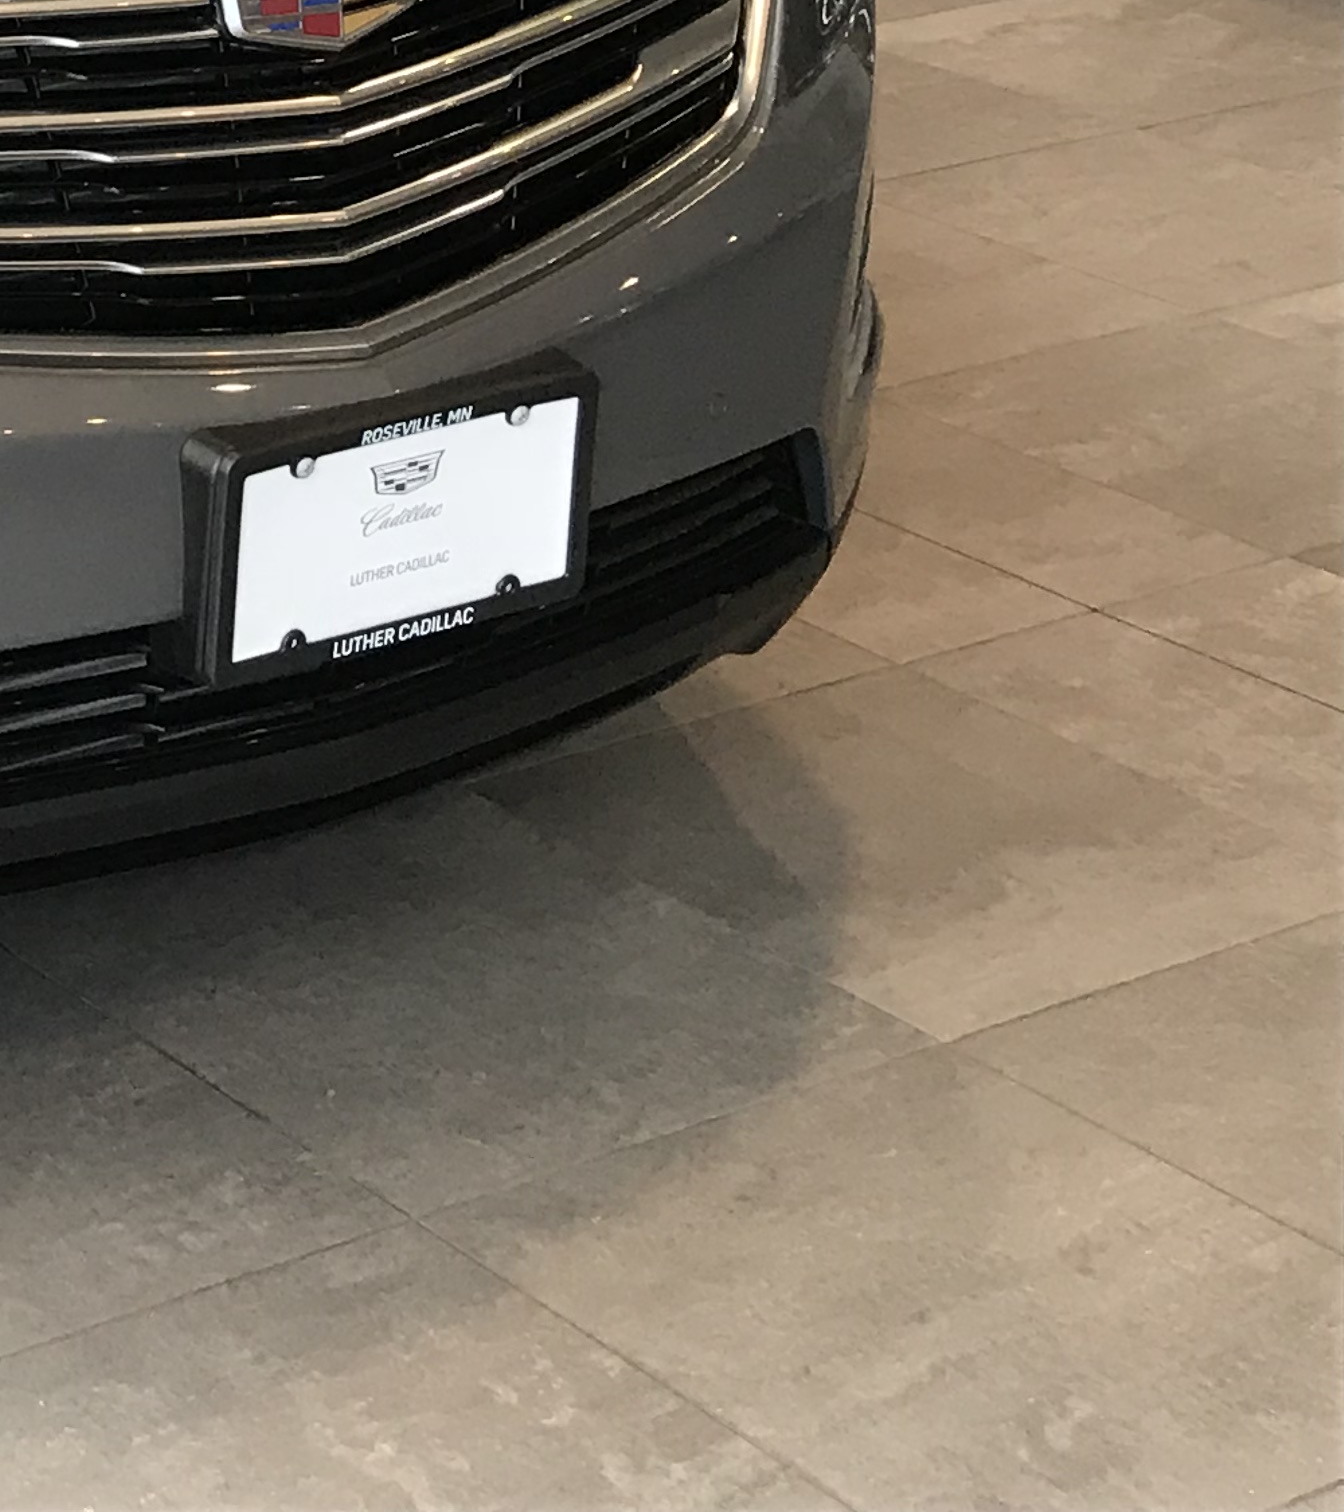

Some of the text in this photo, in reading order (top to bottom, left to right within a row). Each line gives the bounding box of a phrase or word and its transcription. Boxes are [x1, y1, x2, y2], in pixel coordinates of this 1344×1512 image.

[447, 406, 473, 424] MN
[360, 502, 443, 538] Cadillac
[350, 550, 450, 587] LUTHER CADILLAC
[332, 607, 474, 659] LUTHER CADILLAC
